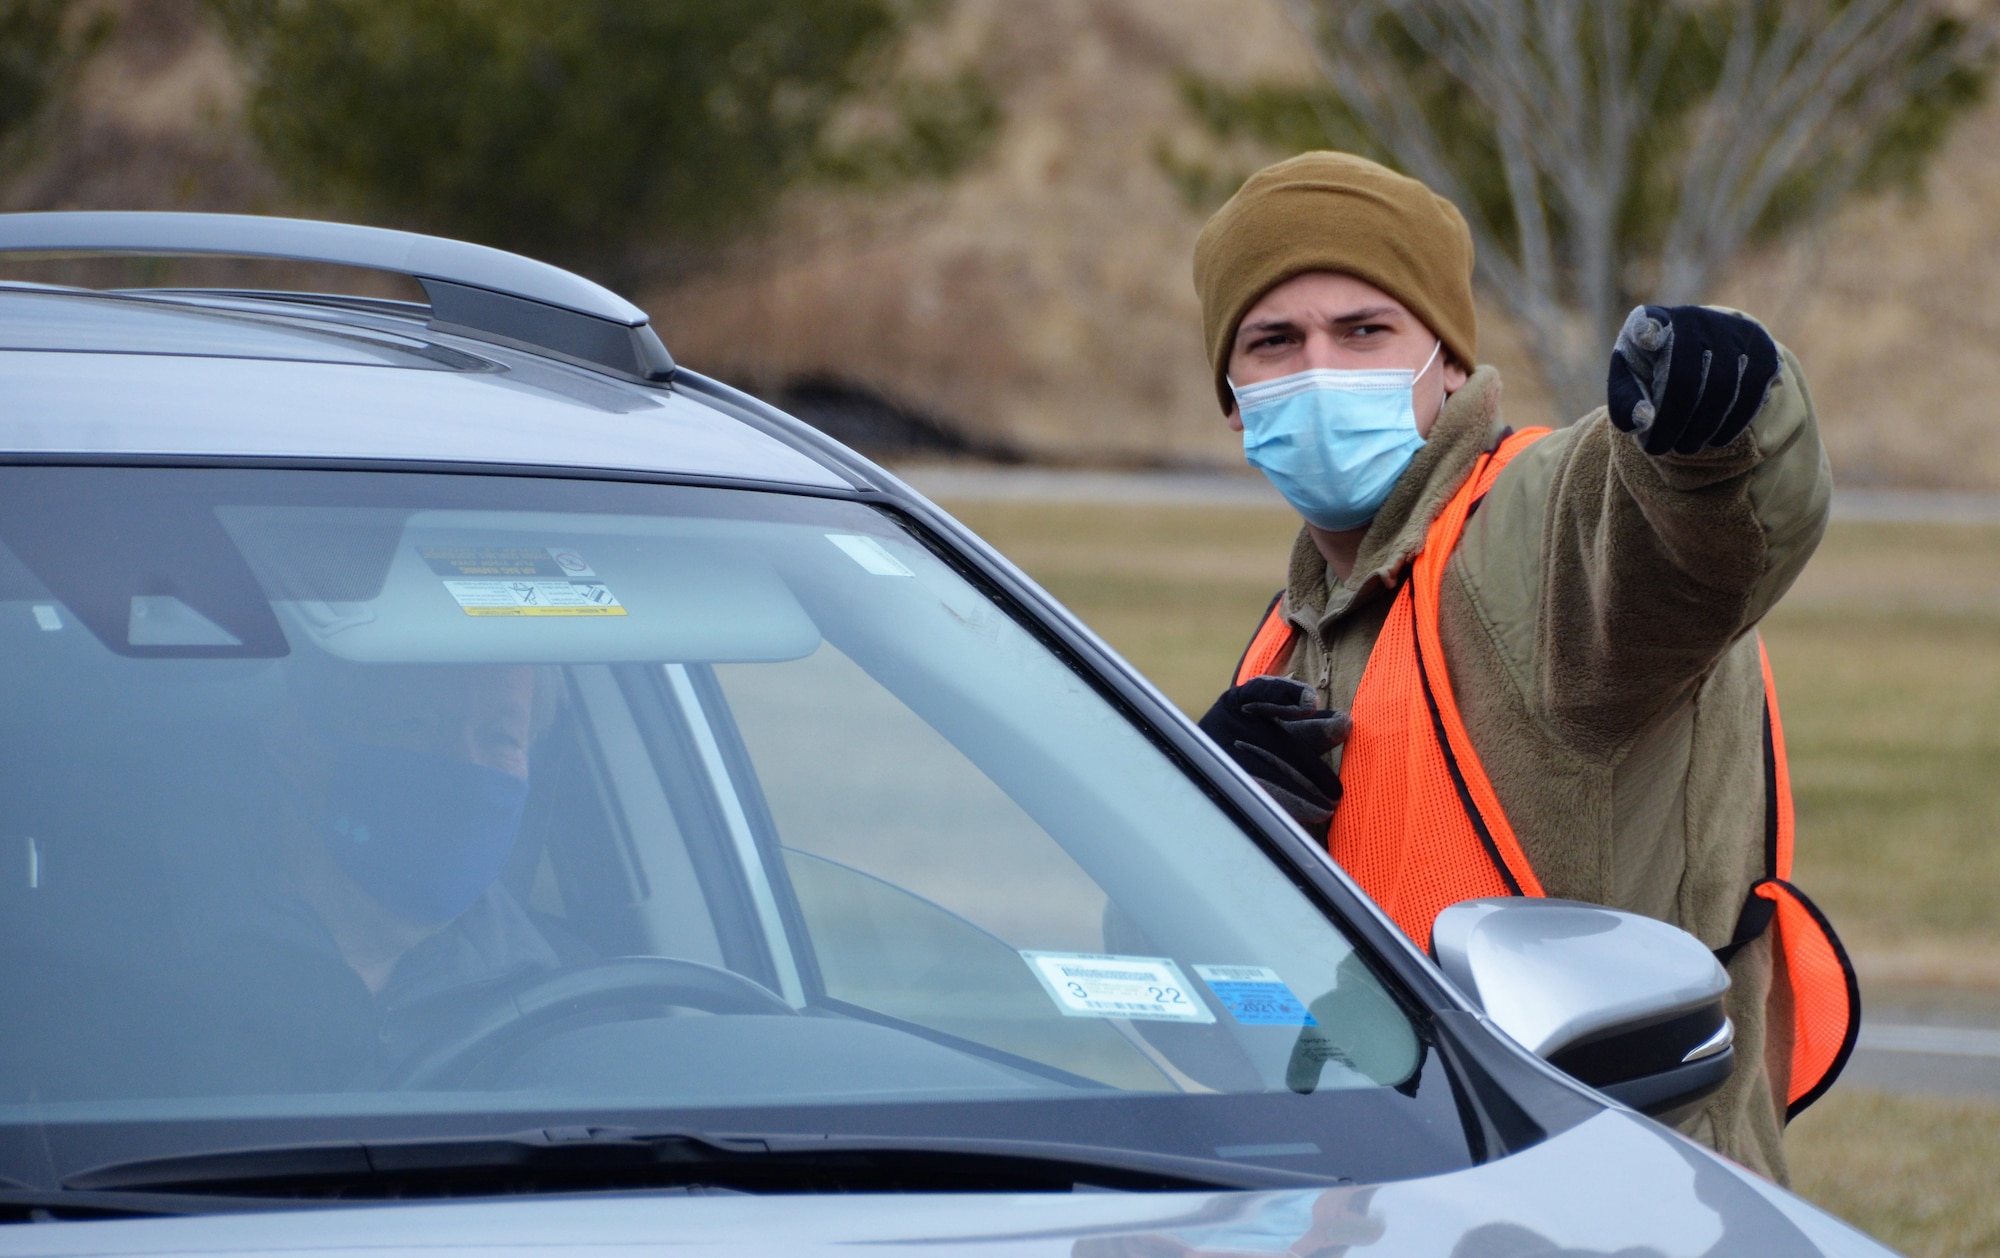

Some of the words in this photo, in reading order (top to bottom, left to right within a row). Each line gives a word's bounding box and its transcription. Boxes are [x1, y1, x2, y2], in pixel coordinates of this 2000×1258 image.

[1067, 982, 1088, 998] 3
[1148, 987, 1187, 1004] 22
[1238, 1001, 1277, 1013] 2021
